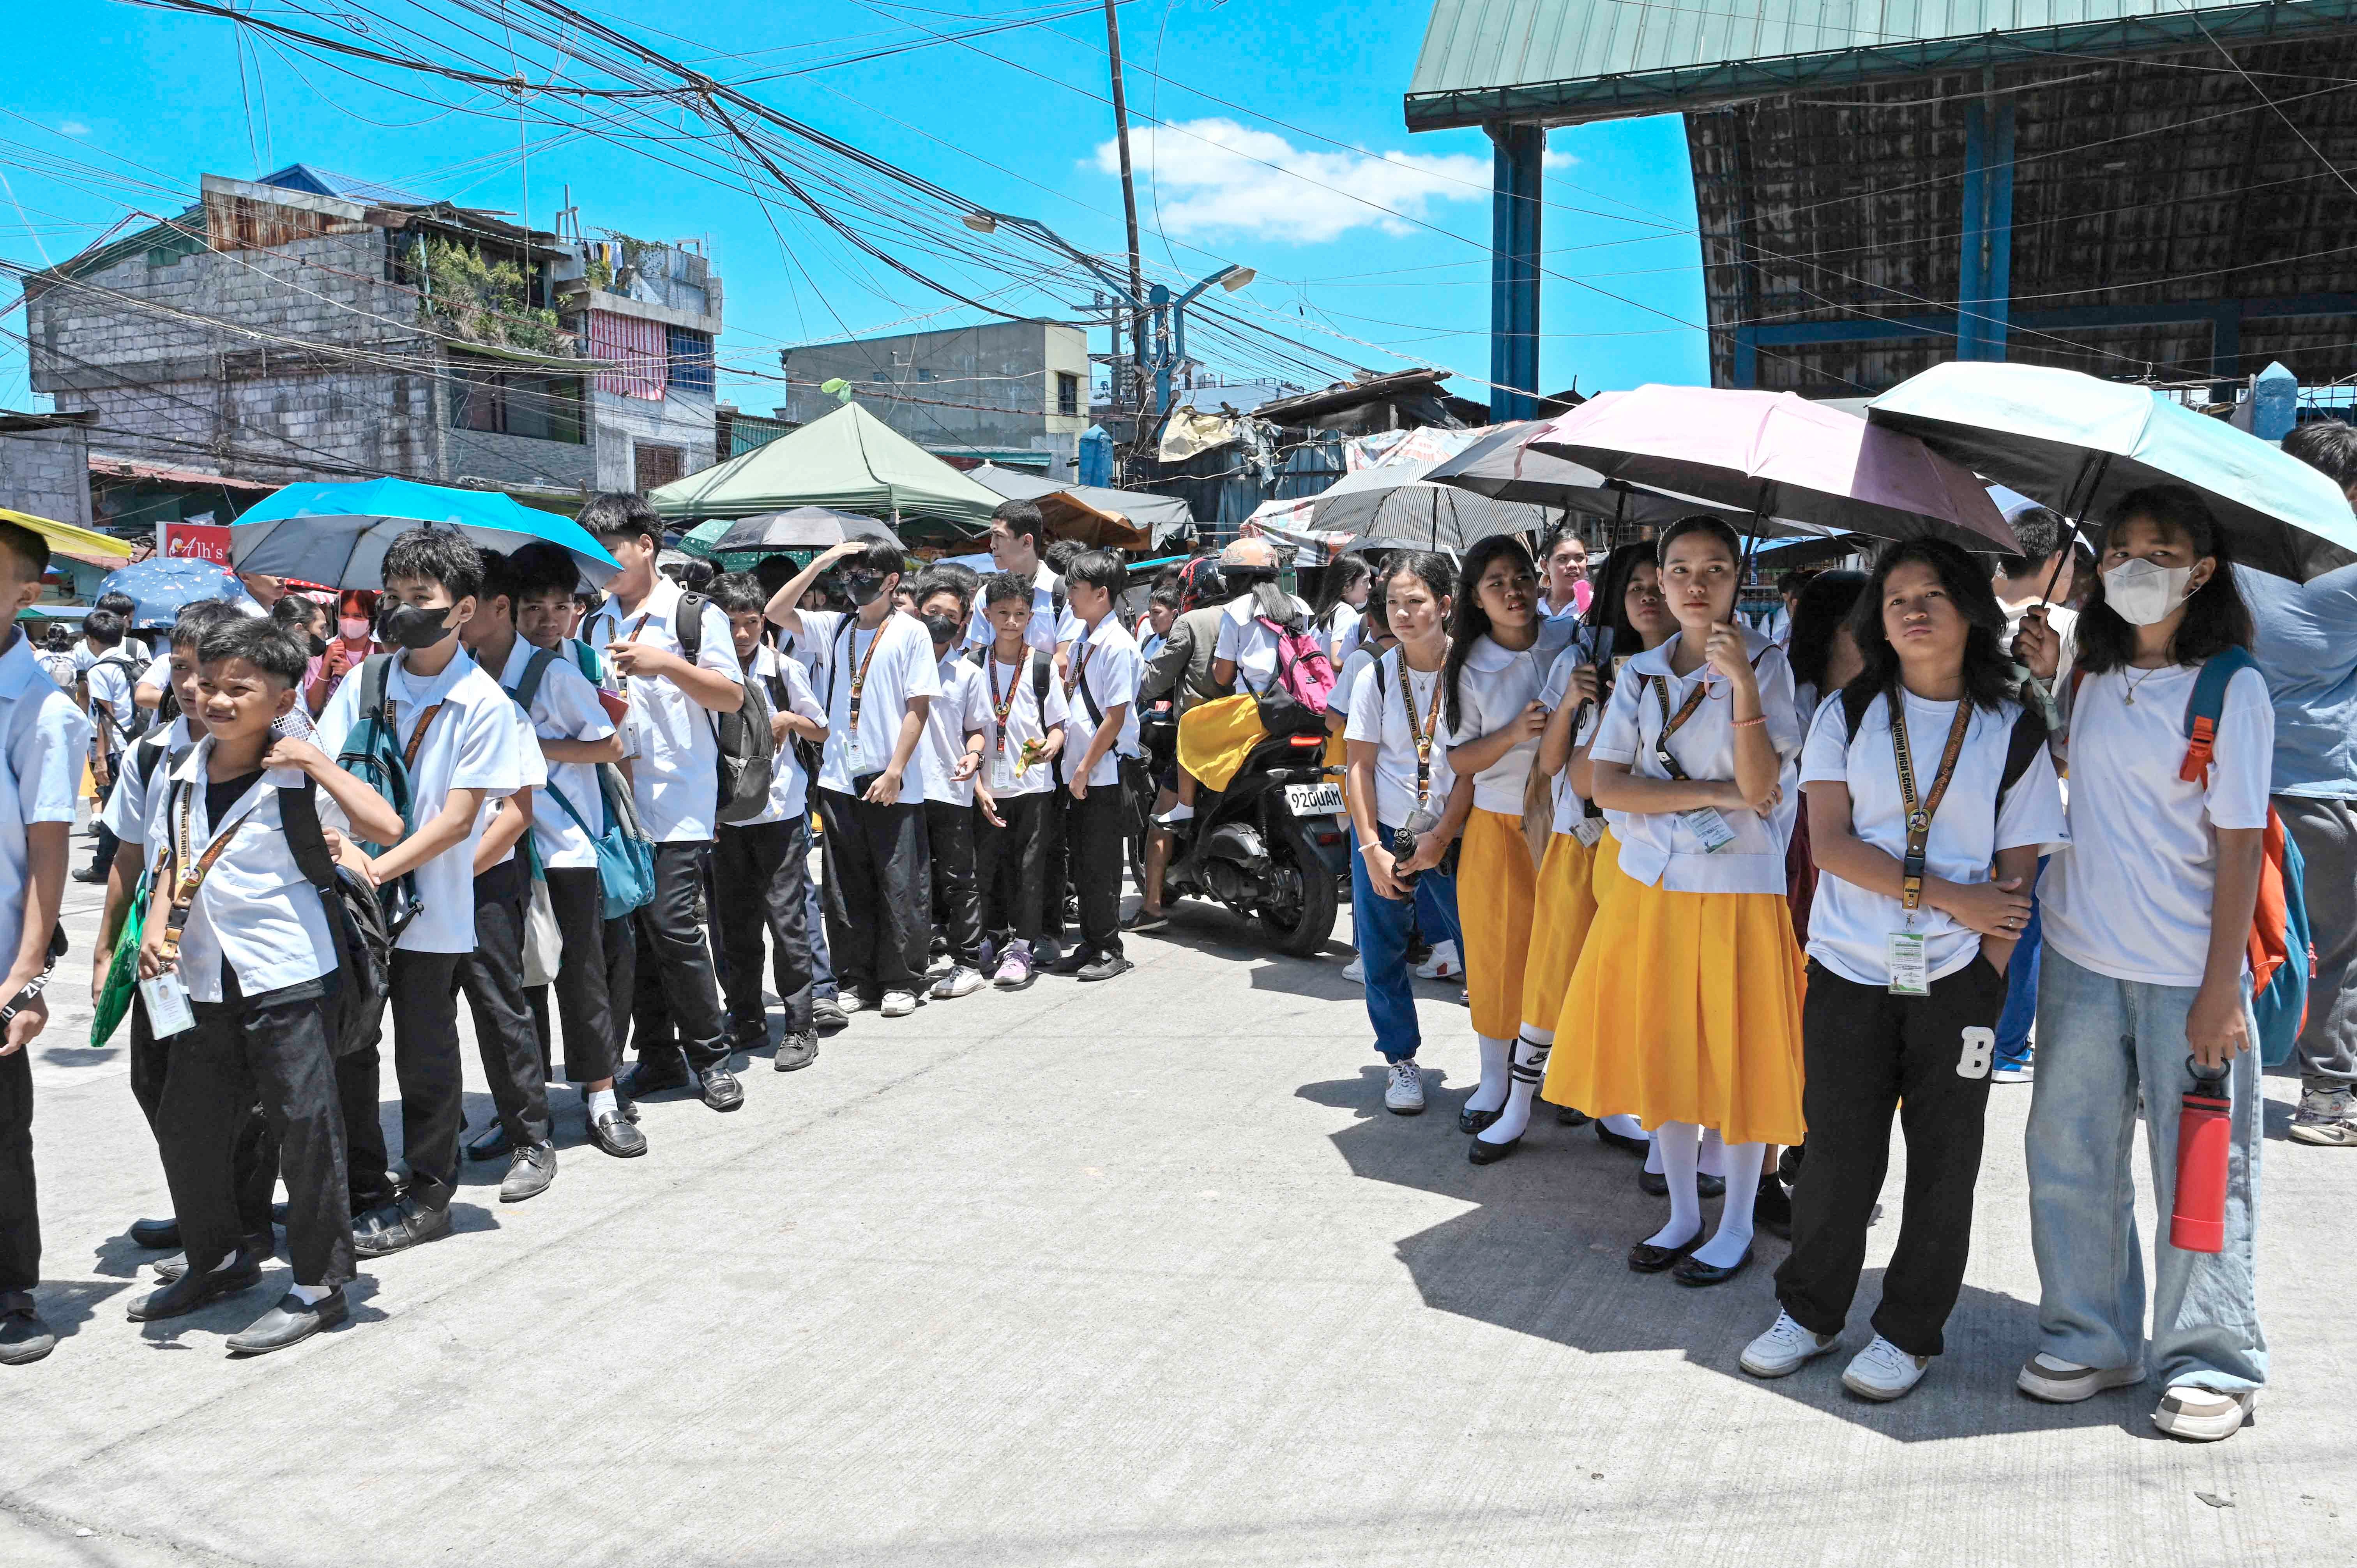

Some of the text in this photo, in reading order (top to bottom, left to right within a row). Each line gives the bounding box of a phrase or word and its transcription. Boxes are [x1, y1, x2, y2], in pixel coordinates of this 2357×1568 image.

[182, 537, 223, 559] Alh's
[1402, 680, 1410, 698] AQUINO
[1408, 712, 1417, 732] SCHOOL
[1657, 683, 1665, 695] HIGH
[1894, 723, 1914, 804] AQUINO HIGH SCHOOL
[1292, 790, 1342, 808] 920UAM
[1956, 1026, 1995, 1079] B
